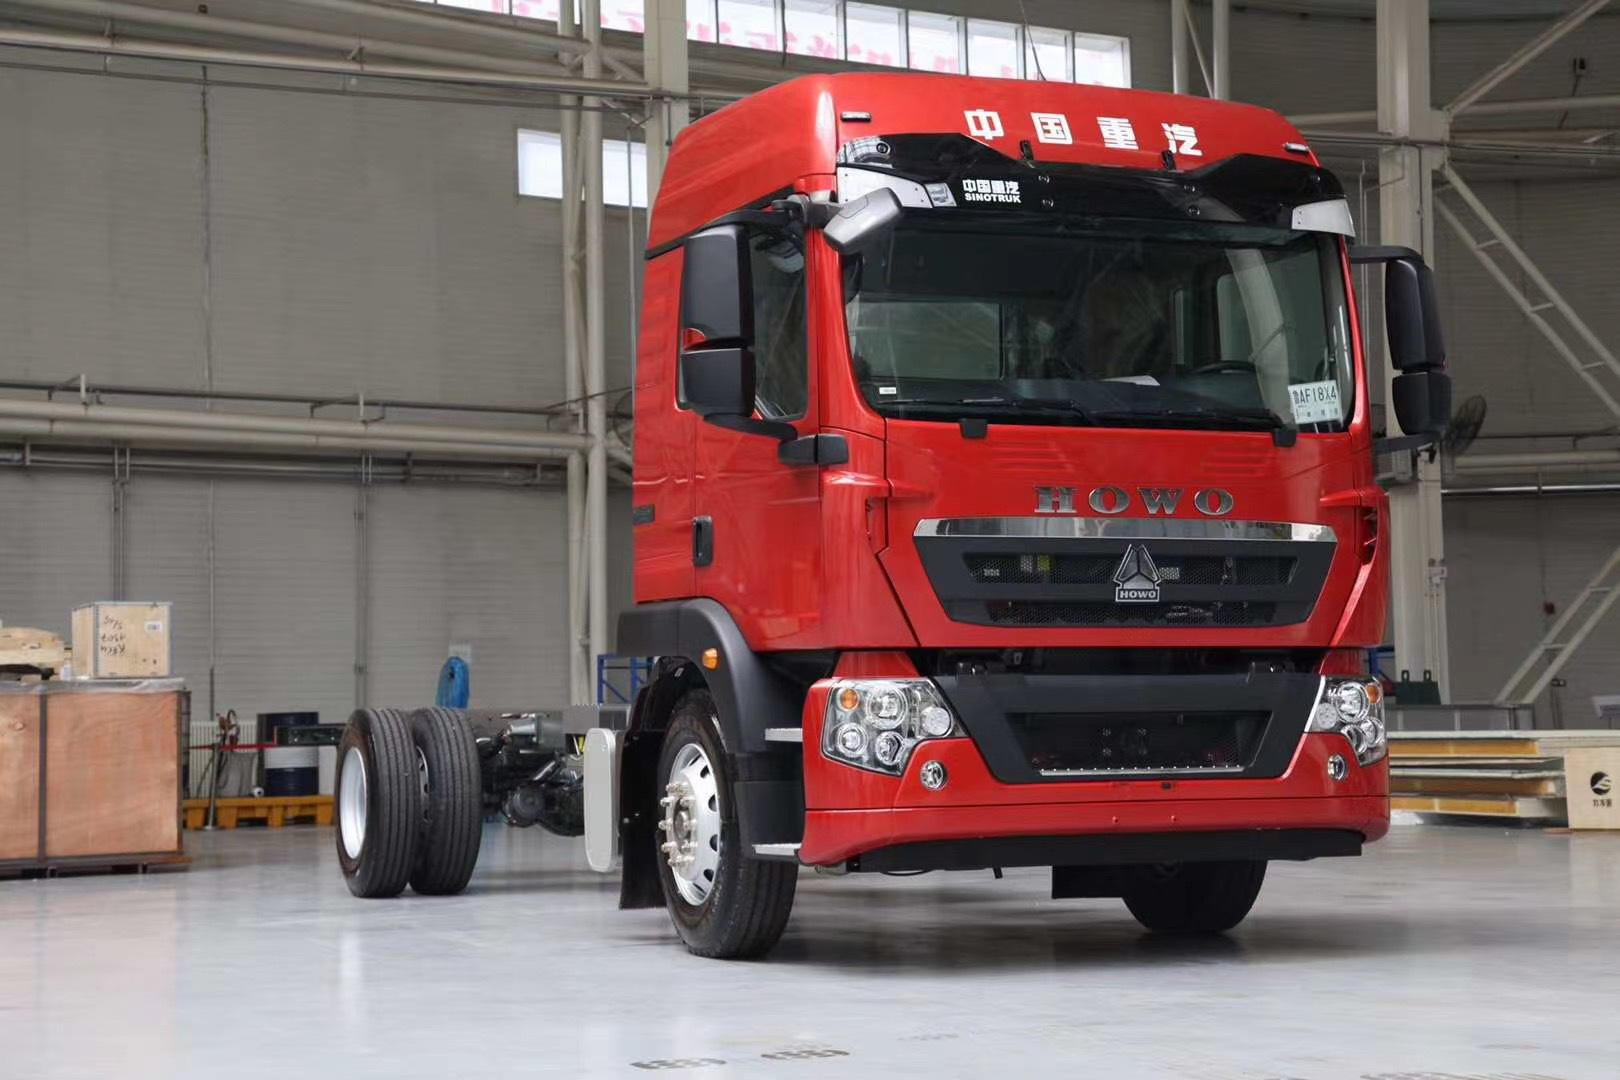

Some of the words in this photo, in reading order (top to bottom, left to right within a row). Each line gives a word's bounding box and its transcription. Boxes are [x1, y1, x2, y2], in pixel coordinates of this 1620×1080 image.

[964, 109, 1202, 156] 中国重汽
[962, 179, 1020, 195] 中国重汽
[964, 192, 1022, 204] SINOTRUK
[1034, 487, 1235, 515] HOWO
[1120, 590, 1156, 599] HOWO
